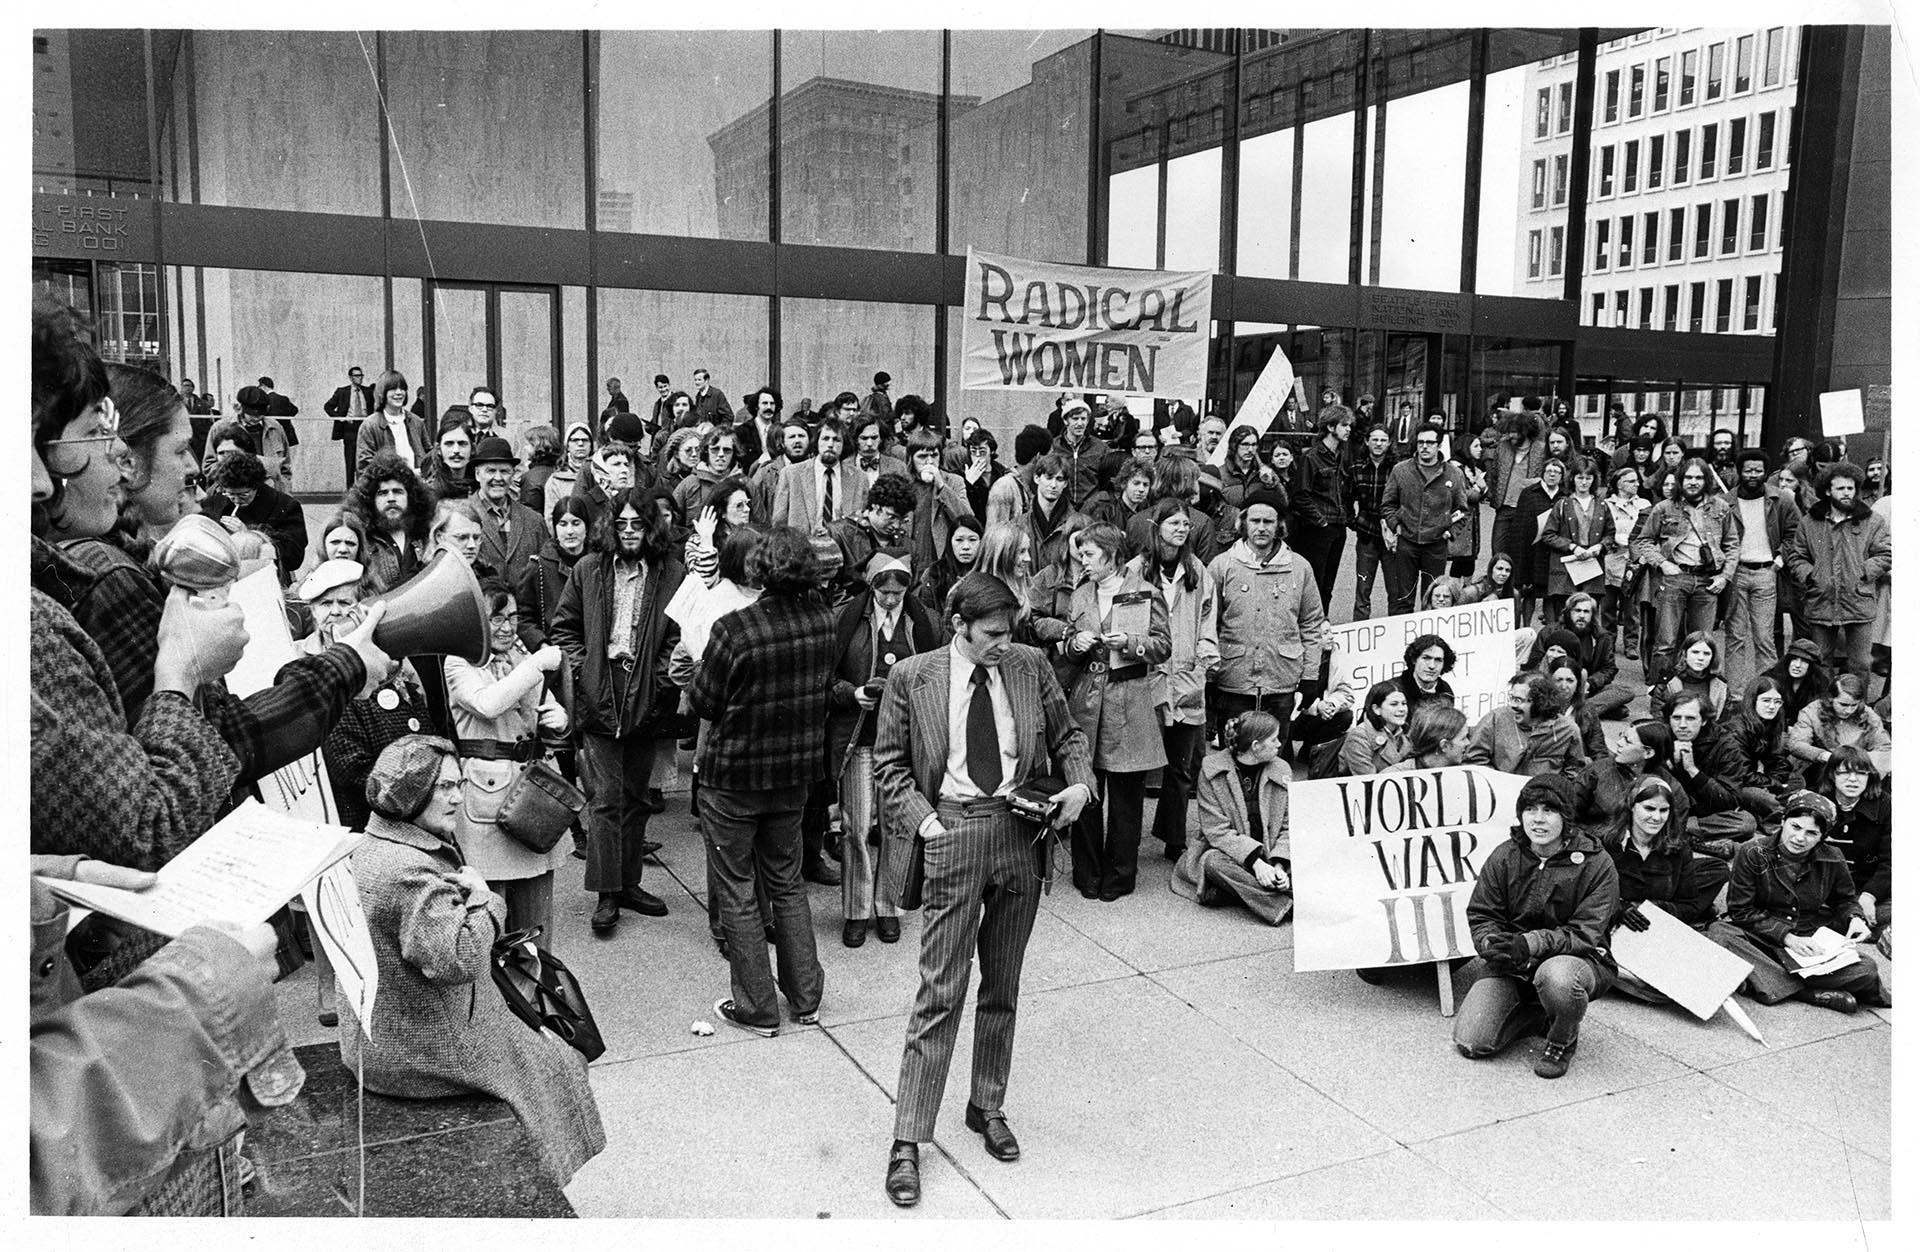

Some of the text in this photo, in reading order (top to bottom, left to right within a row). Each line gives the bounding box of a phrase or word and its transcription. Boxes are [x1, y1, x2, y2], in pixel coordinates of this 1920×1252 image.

[34, 232, 125, 250] G 1001
[62, 220, 129, 237] BANK
[976, 262, 1198, 333] RADICAL
[991, 329, 1161, 393] WOMEN
[1404, 607, 1511, 647] BOMBING
[1336, 769, 1497, 837] WORLD
[1371, 830, 1479, 891] WAR
[1377, 890, 1465, 964] III
